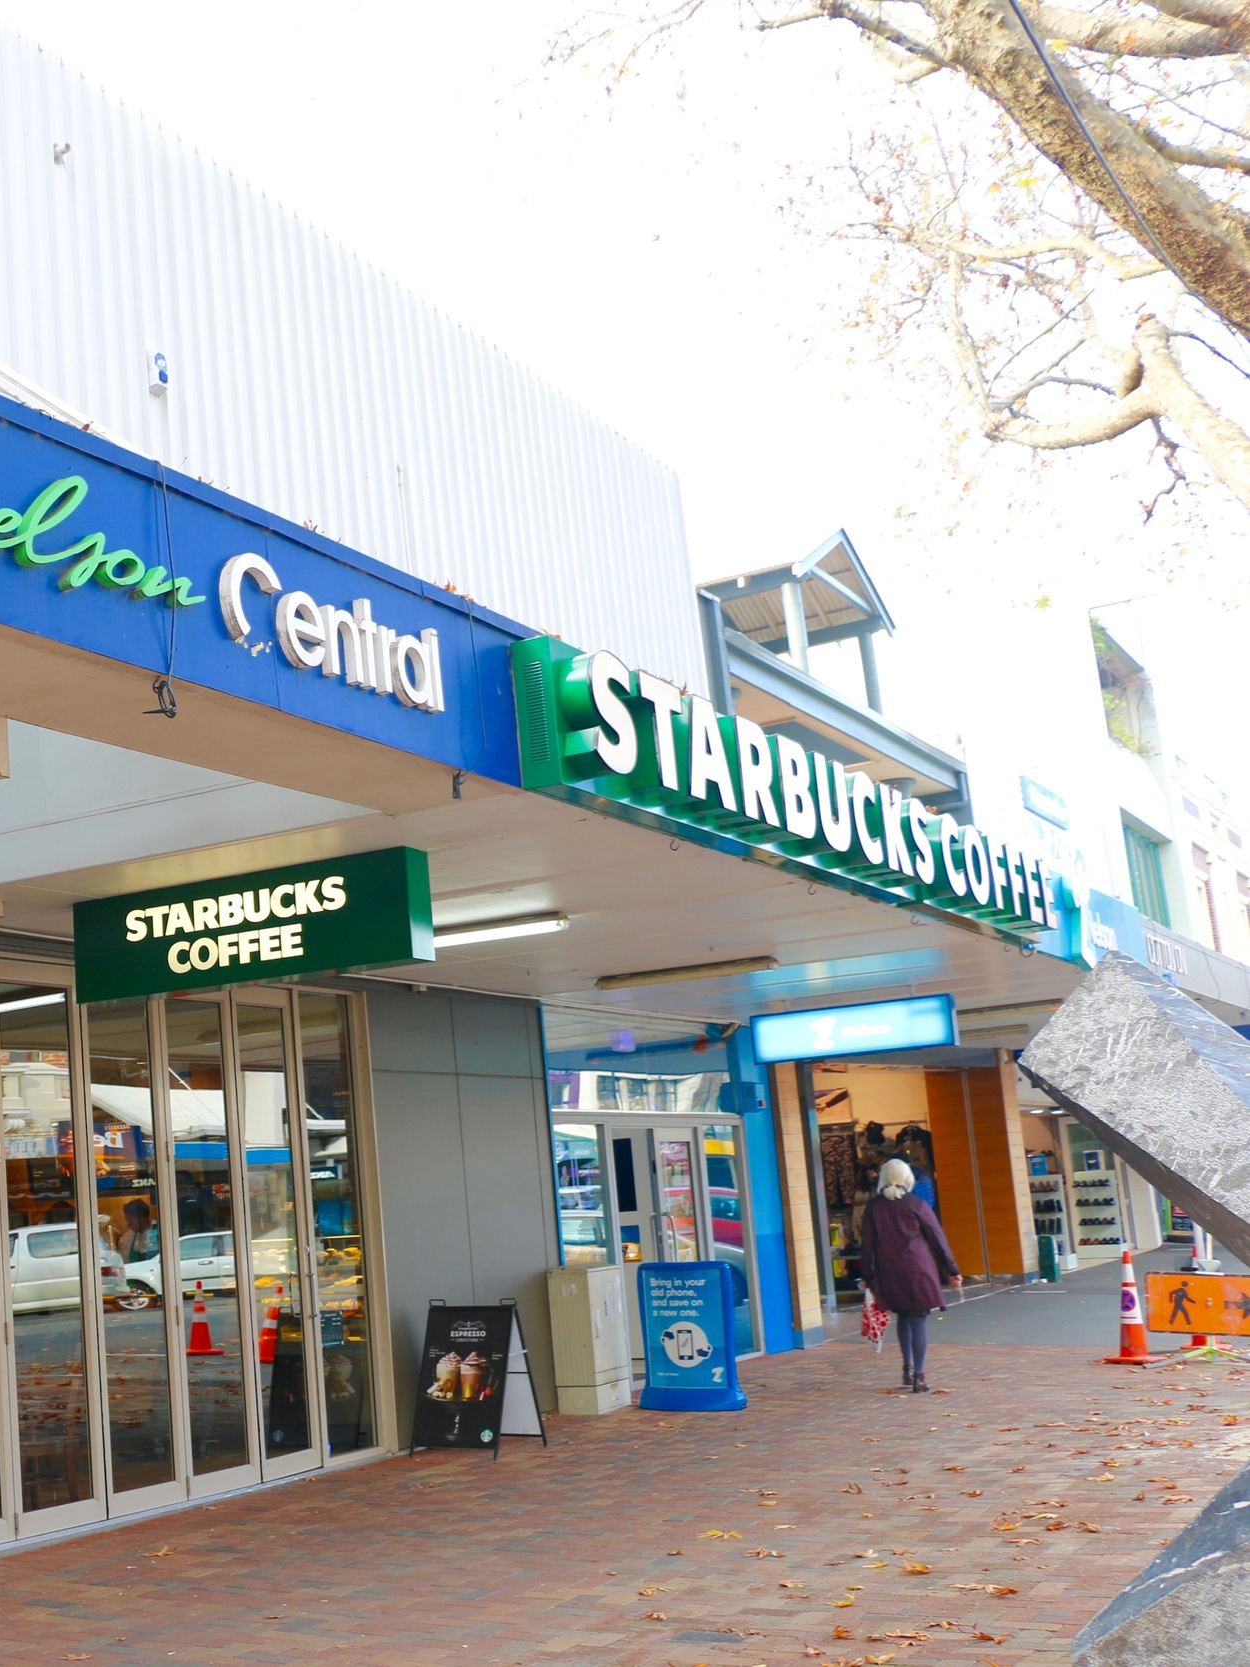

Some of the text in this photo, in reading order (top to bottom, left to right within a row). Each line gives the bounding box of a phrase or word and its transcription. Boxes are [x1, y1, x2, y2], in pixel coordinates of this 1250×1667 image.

[218, 552, 445, 713] Central
[588, 649, 935, 886] STARBUCKS
[941, 813, 1059, 931] COFFEE
[125, 876, 347, 942] STARBUCKS
[167, 923, 304, 974] COFFEE
[650, 1278, 706, 1288] Bring in your
[651, 1289, 697, 1299] old phone,
[652, 1299, 703, 1307] and save on
